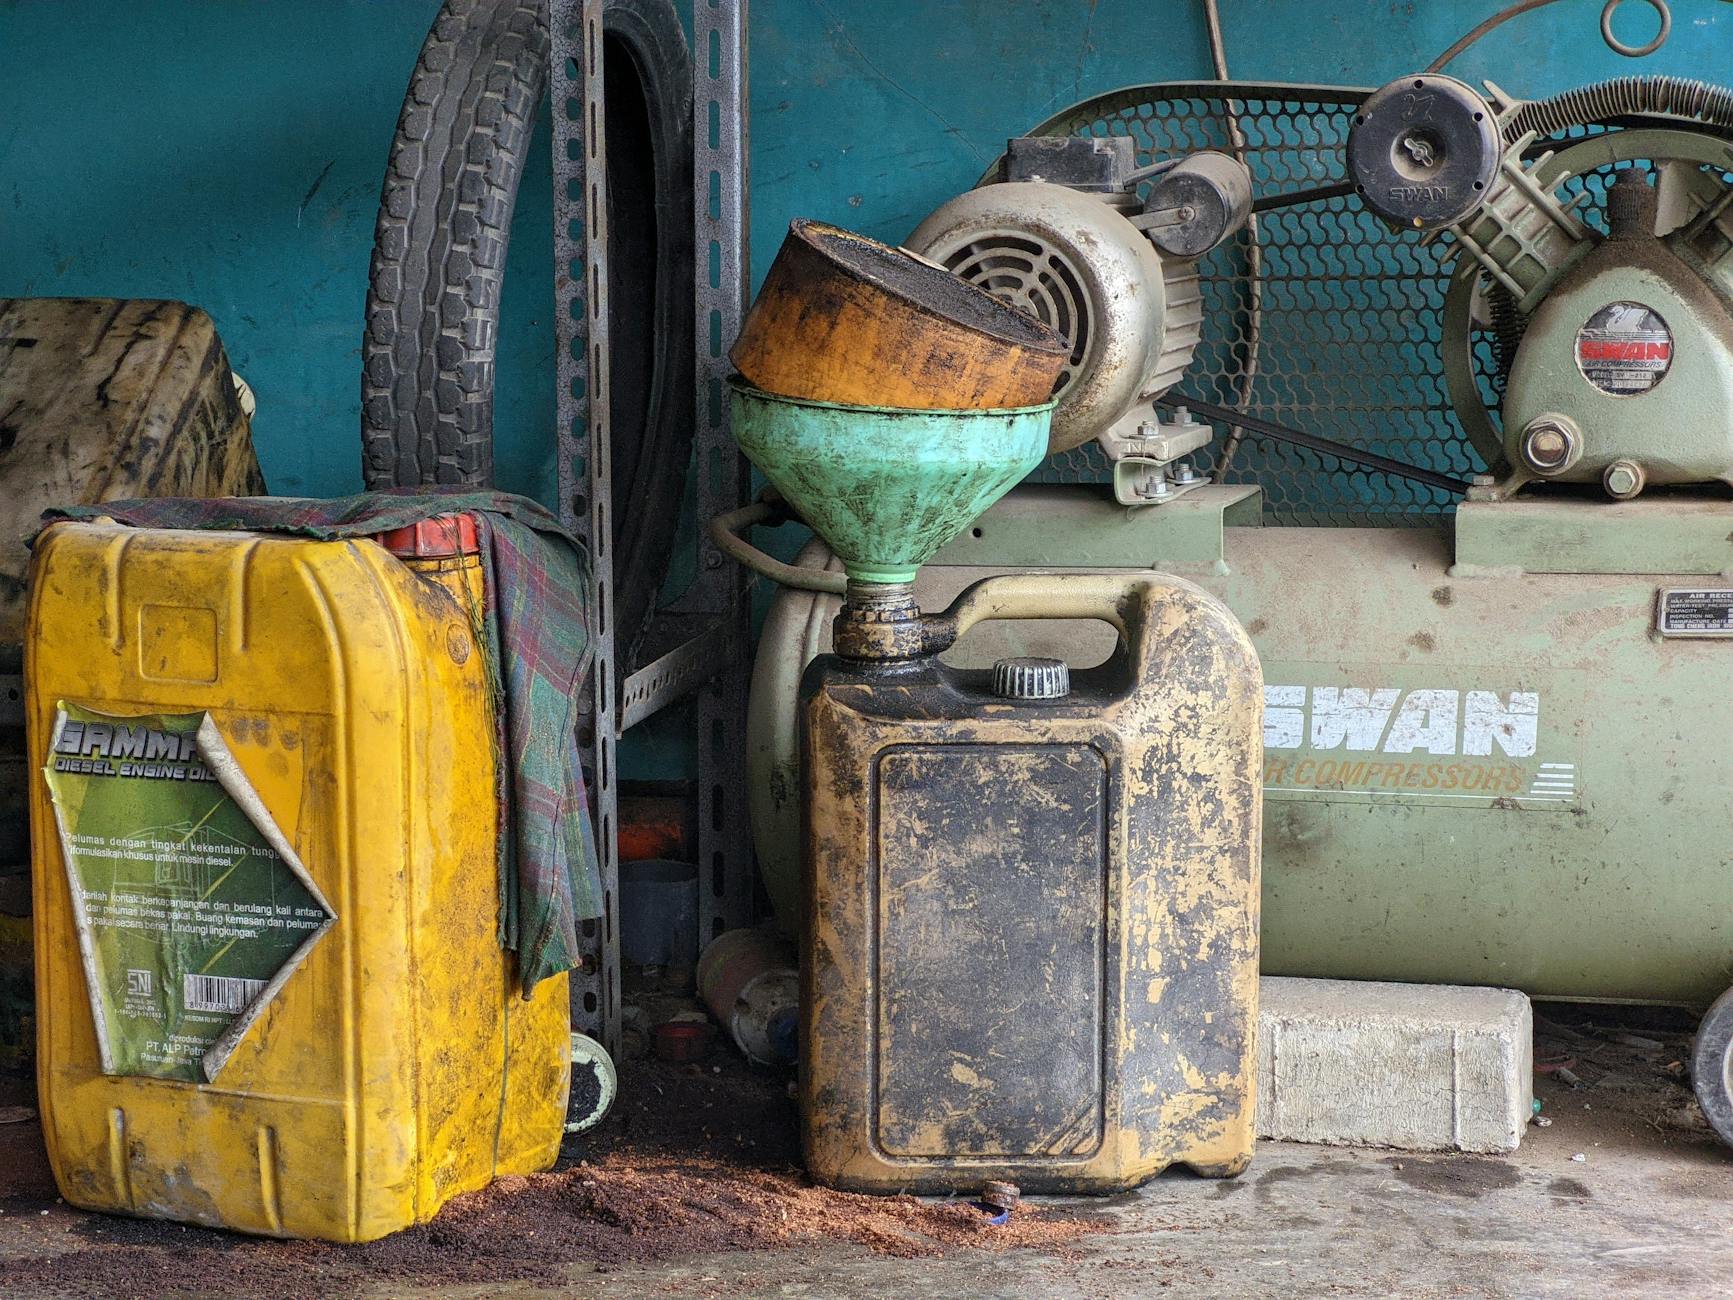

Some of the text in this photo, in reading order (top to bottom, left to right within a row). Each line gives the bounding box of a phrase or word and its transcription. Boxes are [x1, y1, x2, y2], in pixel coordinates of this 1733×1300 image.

[1390, 187, 1448, 201] SWAN
[1581, 341, 1669, 360] SWAN
[1264, 685, 1539, 757] SWAN
[55, 757, 116, 777] DIESEL
[119, 762, 186, 780] ENGINE
[1294, 759, 1523, 793] COMPRESSORS
[70, 845, 234, 867] iformulasikan khusus untuk mesin diesel.
[110, 837, 146, 849] dengan
[151, 840, 186, 852] tingkat
[190, 842, 247, 855] kekentalan
[111, 892, 138, 904] kontak
[213, 901, 230, 911] dan
[233, 902, 272, 916] berulang
[275, 905, 291, 916] kali
[294, 907, 323, 918] antara
[140, 908, 166, 919] bekas
[195, 912, 223, 924] Buang
[225, 914, 265, 926] kemasan
[267, 917, 284, 928] dan
[115, 919, 144, 929] secara
[171, 922, 209, 936] Lindungi
[209, 925, 259, 939] lingkungan.
[127, 971, 152, 994] SNI
[162, 1043, 181, 1054] ALP
